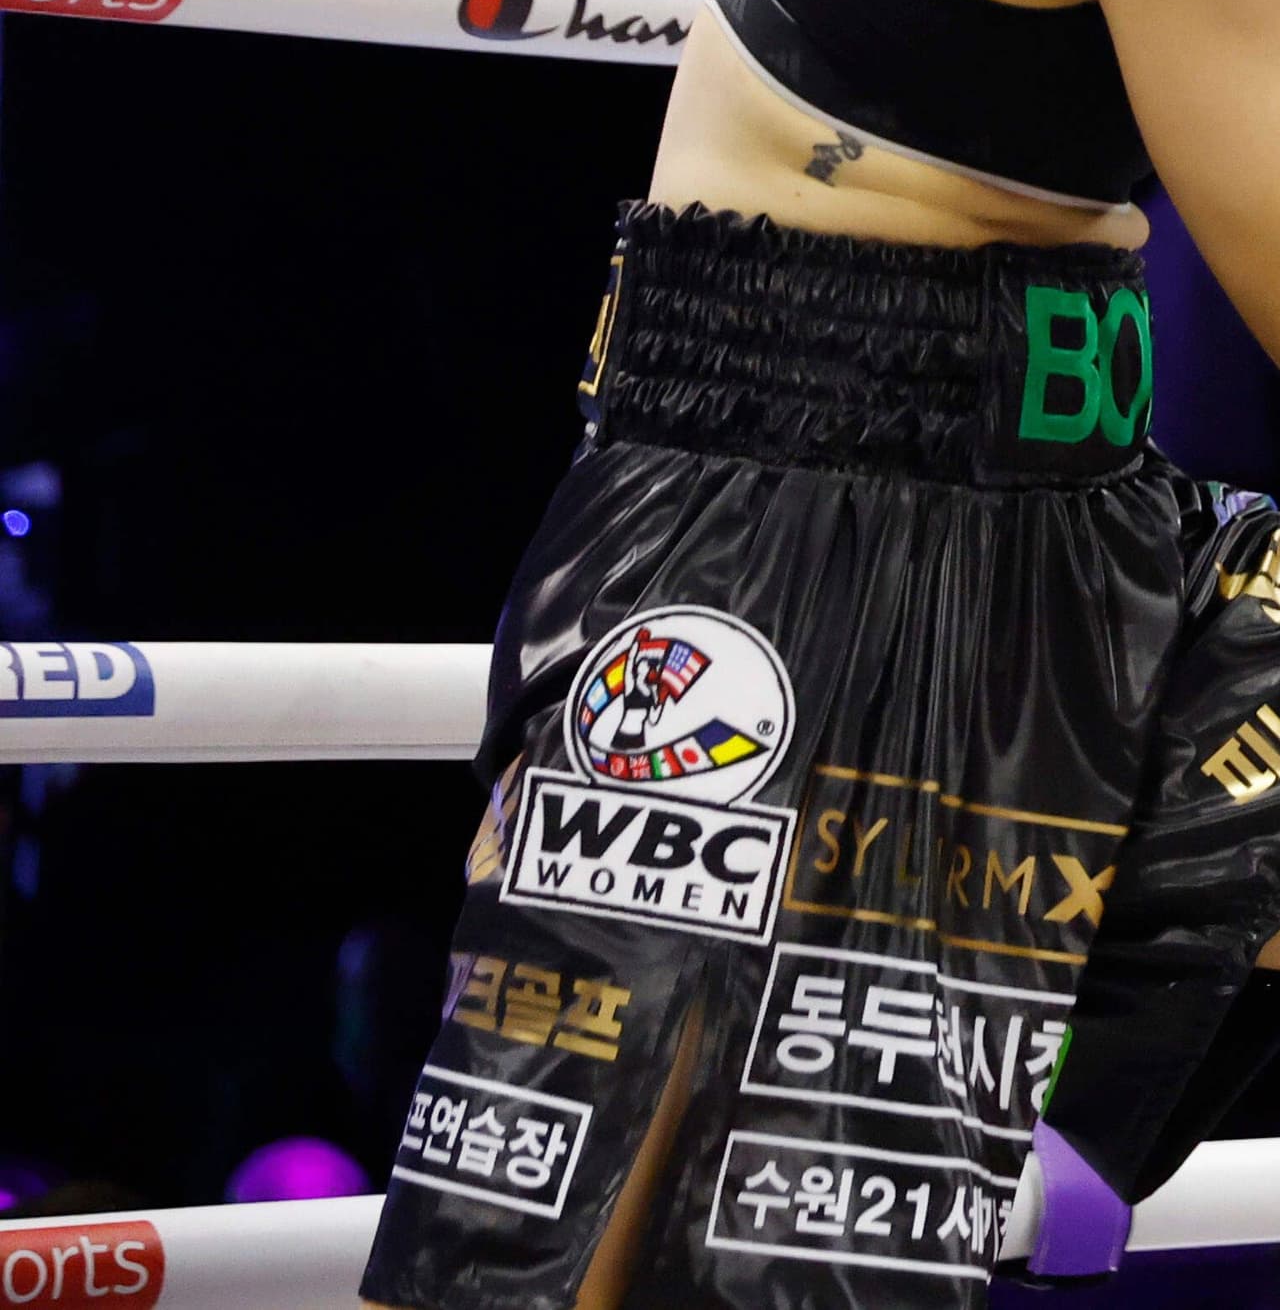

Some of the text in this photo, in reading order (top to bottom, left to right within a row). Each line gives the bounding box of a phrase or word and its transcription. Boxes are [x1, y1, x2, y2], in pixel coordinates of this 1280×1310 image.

[540, 793, 772, 885] WBC
[537, 858, 749, 921] WOMEN
[3, 1235, 149, 1303] orts
